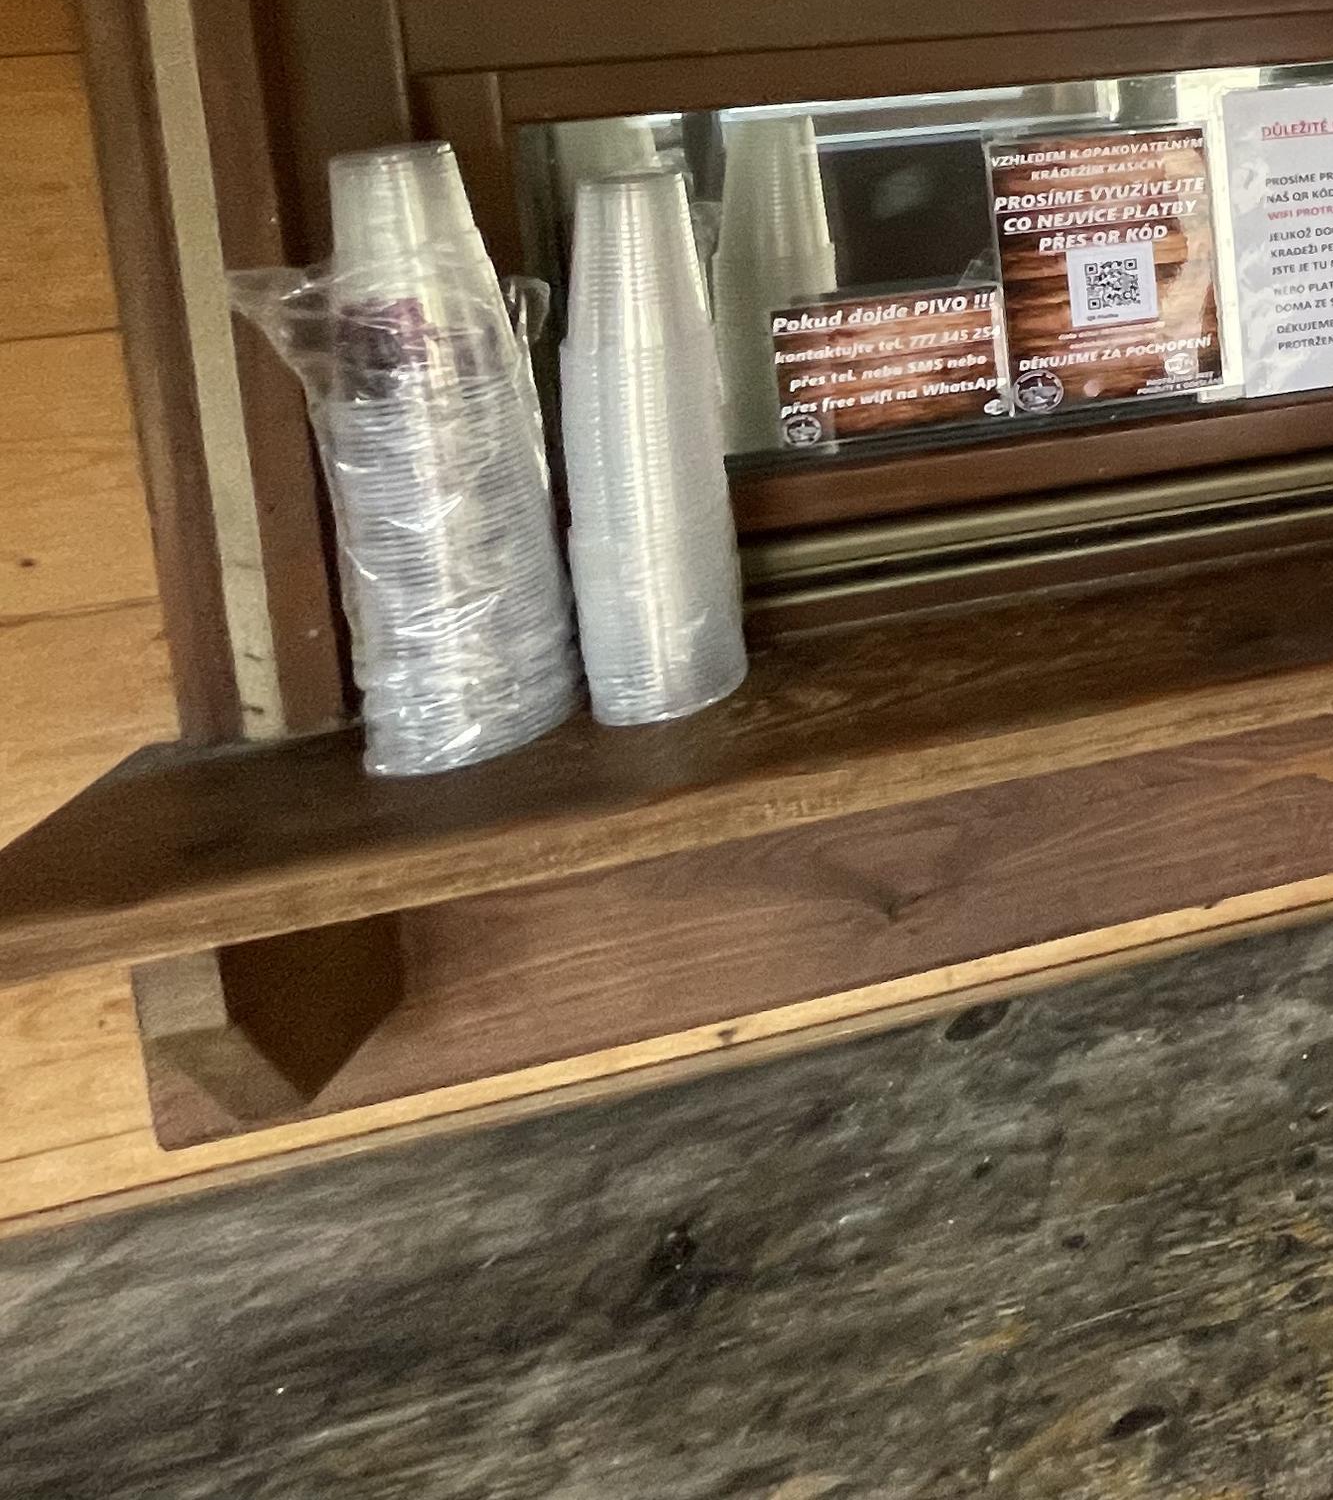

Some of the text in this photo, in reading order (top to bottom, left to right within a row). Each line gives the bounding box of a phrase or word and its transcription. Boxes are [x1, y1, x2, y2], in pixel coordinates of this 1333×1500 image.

[1261, 118, 1328, 139] DŮLEŽITÉ
[994, 176, 1205, 212] PROSÍME VYUŽÍVEJTE
[1265, 172, 1316, 187] PROSÍME
[1003, 199, 1197, 232] CO NEJVÍCE PLATBY
[1039, 228, 1087, 252] PŘES
[1125, 224, 1168, 244] KÓD
[772, 309, 843, 333] Pokud
[847, 303, 909, 326] dojde
[914, 295, 968, 316] PIVO
[1019, 350, 1097, 371] DĚKUJEME
[1101, 348, 1121, 360] ZA
[1125, 334, 1212, 357] POCHOPENÍ
